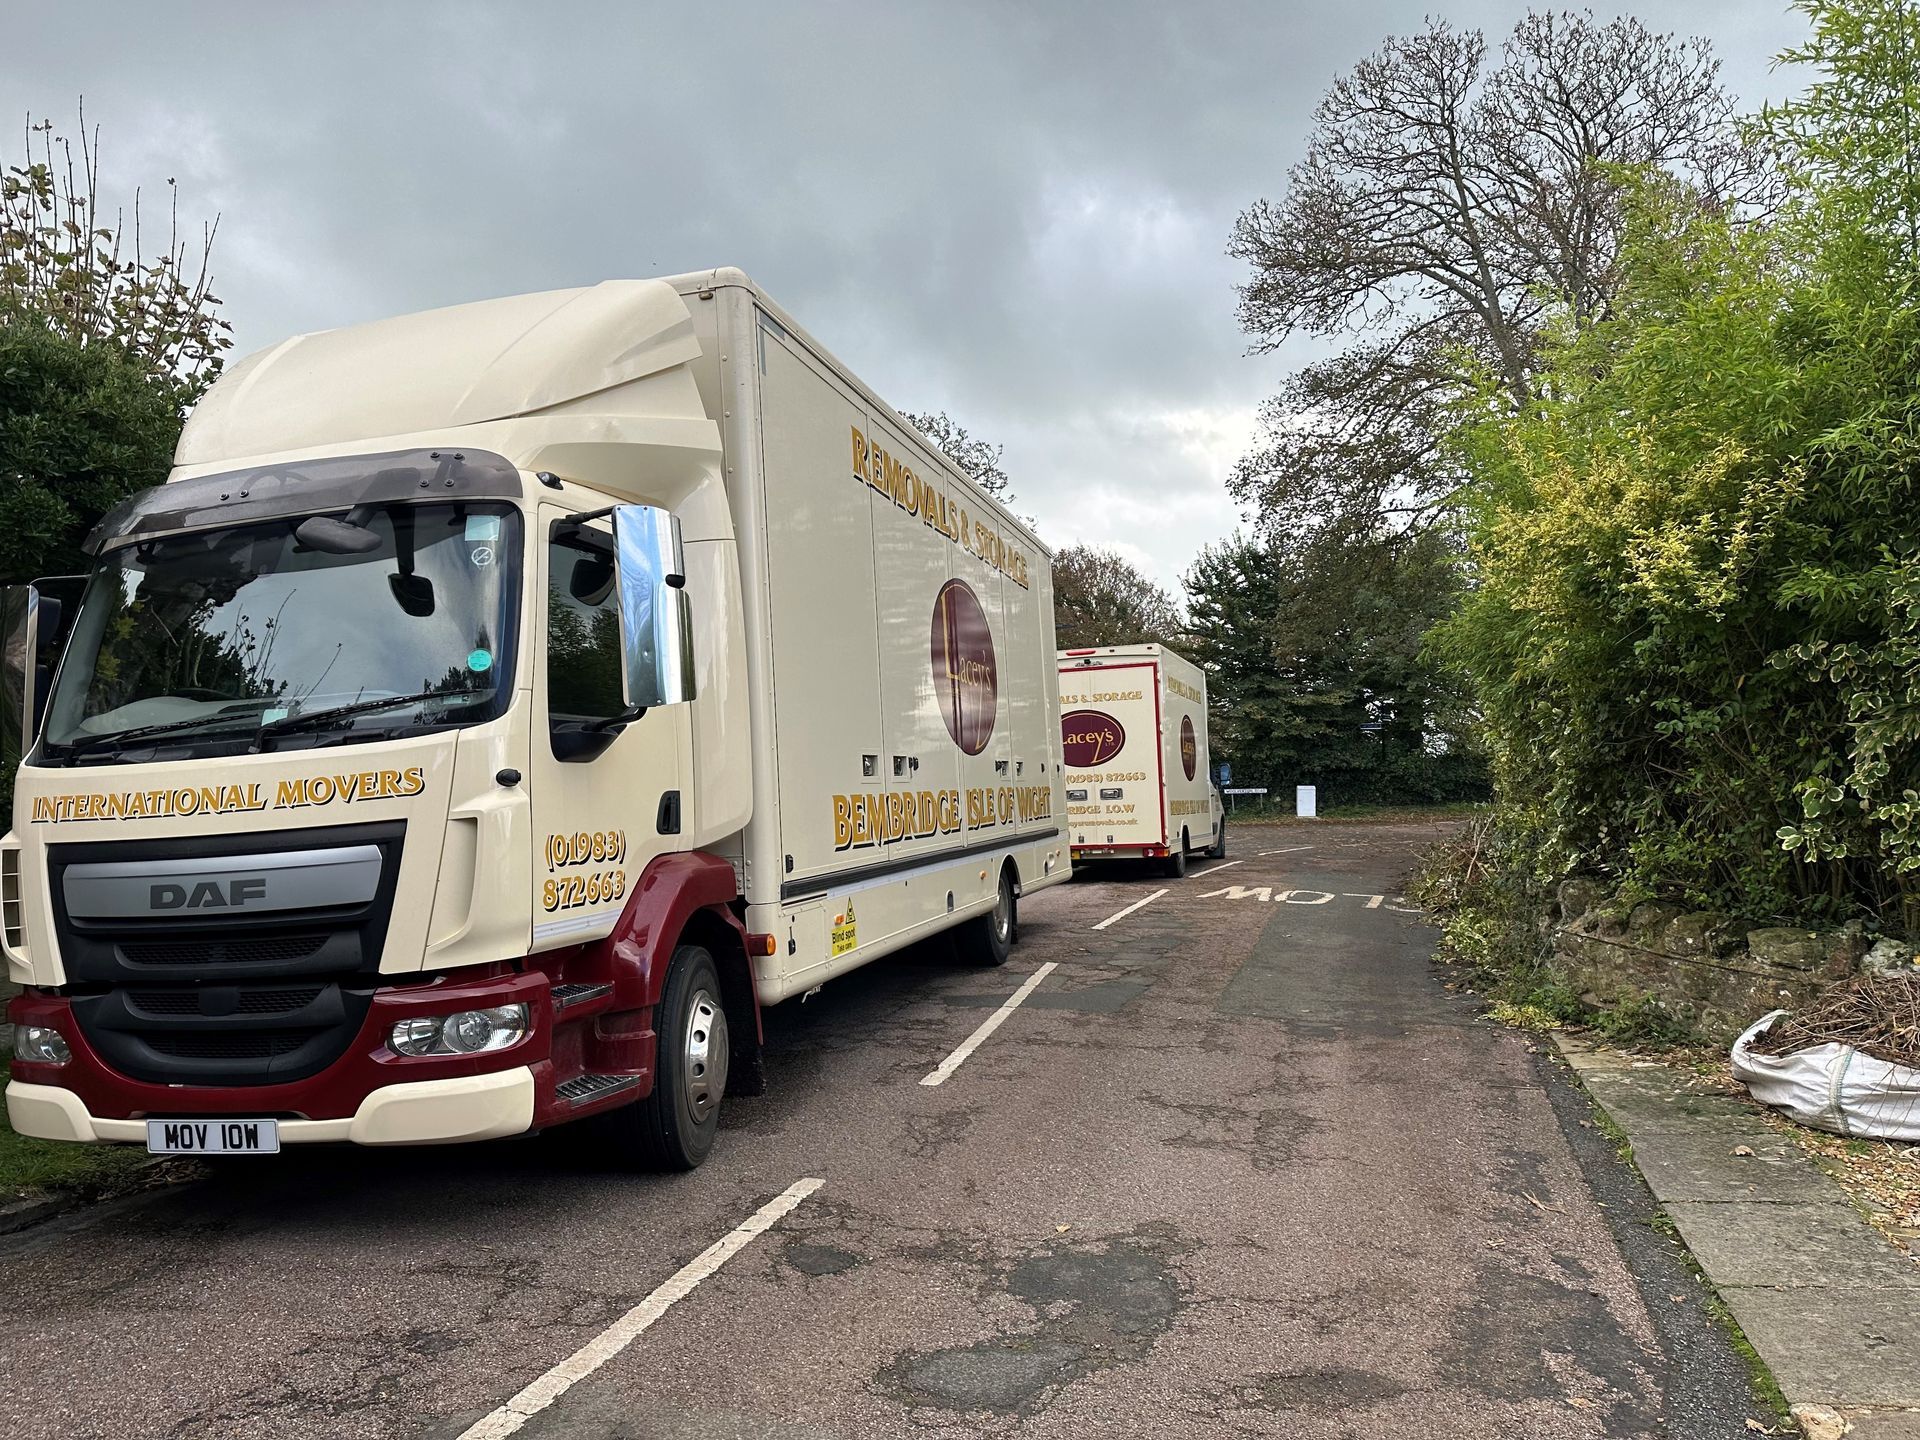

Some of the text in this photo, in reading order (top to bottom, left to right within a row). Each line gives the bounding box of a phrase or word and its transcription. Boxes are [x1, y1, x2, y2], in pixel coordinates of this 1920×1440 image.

[851, 425, 1029, 591] REMOVALS & STORAGE
[940, 589, 992, 750] Lacey's
[1060, 690, 1143, 705] ALS & STORAGE
[31, 767, 426, 824] INTERNATIONAL MOVERS
[1066, 772, 1147, 785] (01983) 872663
[832, 786, 1052, 852] BEMBRIDGE ISLE OF WIGHT
[1067, 804, 1102, 815] RIDGE
[544, 829, 626, 873] (01983)
[149, 878, 267, 910] DAF
[542, 870, 625, 912] 872663
[832, 927, 855, 944] Blind spot
[165, 1123, 208, 1150] MOV
